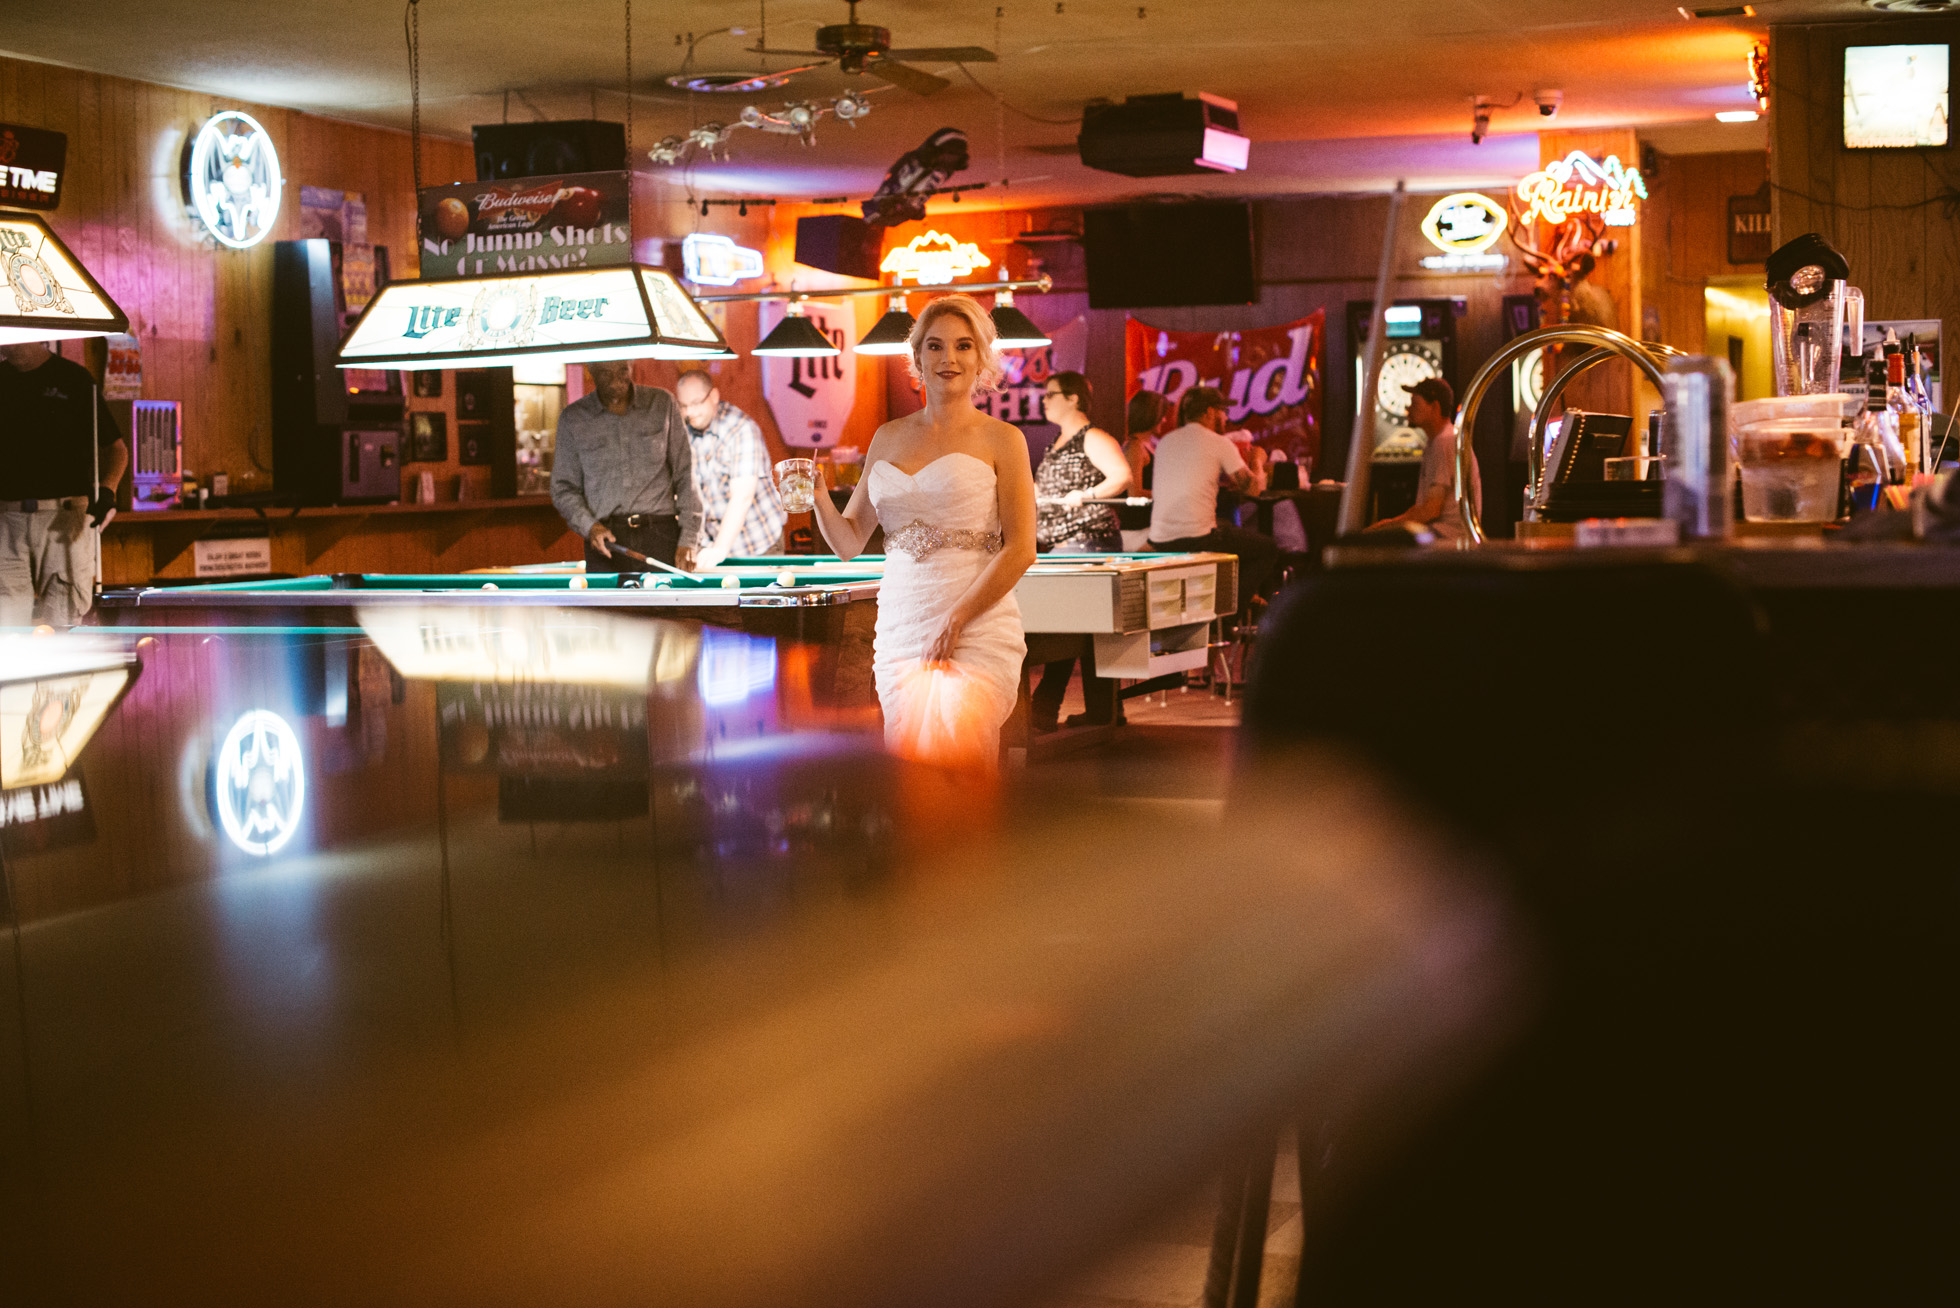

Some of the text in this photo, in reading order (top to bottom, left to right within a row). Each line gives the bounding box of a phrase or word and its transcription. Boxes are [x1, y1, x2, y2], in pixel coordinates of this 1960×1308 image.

[474, 188, 562, 211] Budweiser
[424, 223, 628, 256] No Jump Shots
[457, 247, 588, 276] Or Masse!
[402, 305, 462, 339] Lite
[538, 296, 610, 325] Beer
